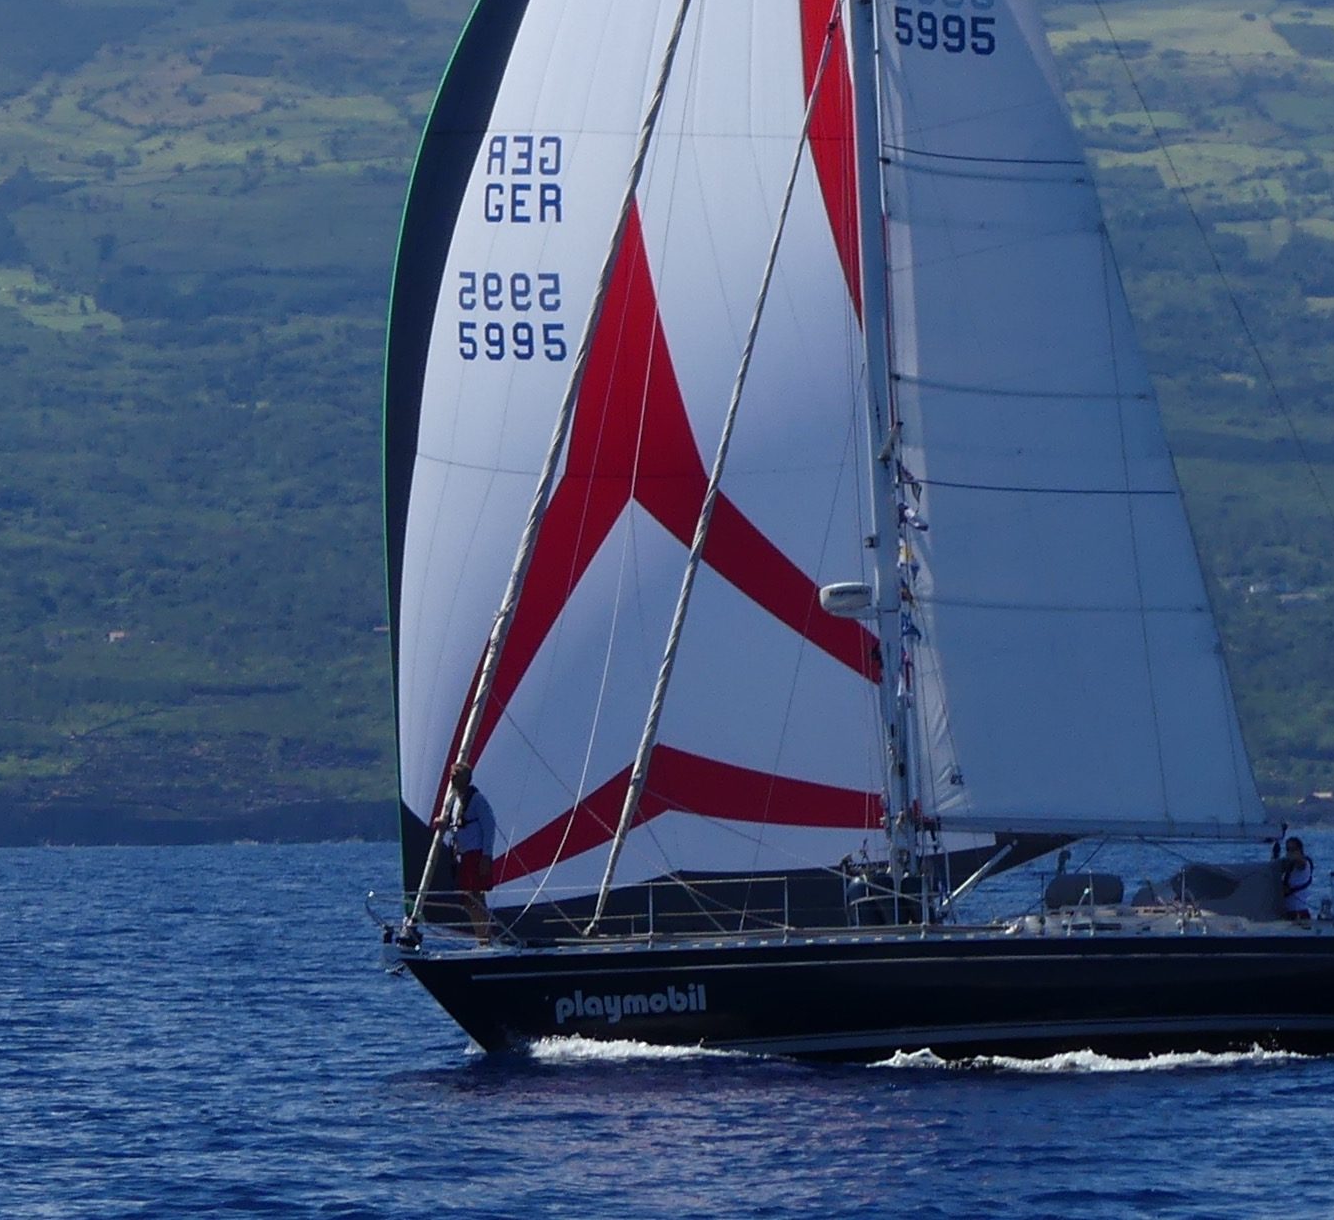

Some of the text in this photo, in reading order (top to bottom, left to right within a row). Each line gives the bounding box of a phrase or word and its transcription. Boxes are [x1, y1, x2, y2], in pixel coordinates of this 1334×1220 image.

[894, 7, 995, 55] 5995
[484, 183, 562, 223] GER
[458, 321, 567, 362] 5995
[555, 983, 707, 1024] playmobil
